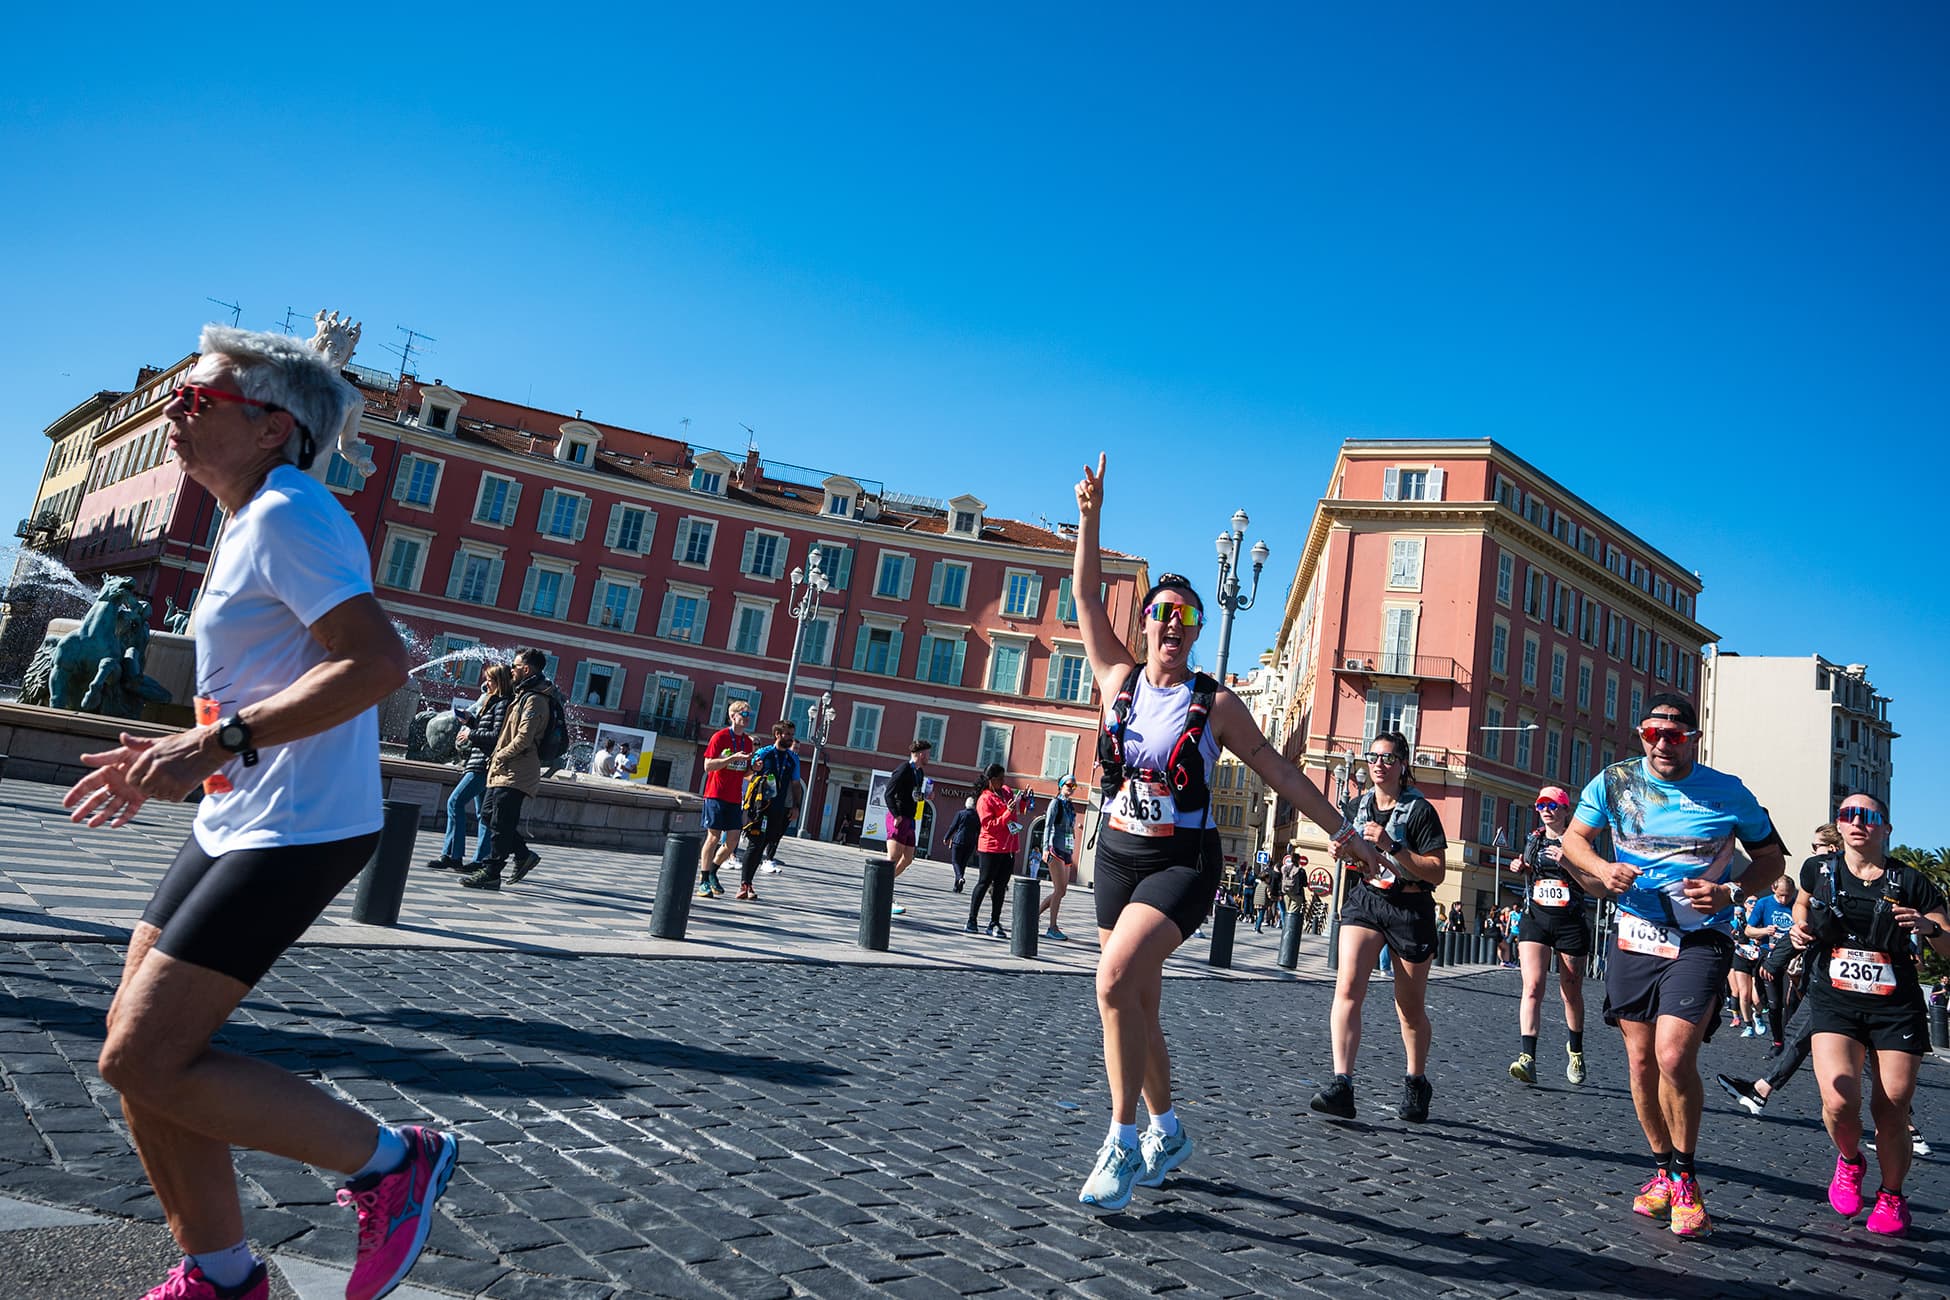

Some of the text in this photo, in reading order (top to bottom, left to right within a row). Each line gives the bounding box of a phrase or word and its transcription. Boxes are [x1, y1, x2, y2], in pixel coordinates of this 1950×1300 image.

[592, 664, 612, 676] HOTEL
[661, 676, 681, 688] HOTEL
[728, 687, 747, 699] HOTEL
[1120, 795, 1162, 821] 3963
[1538, 887, 1563, 899] 3103
[1840, 961, 1883, 982] 2367
